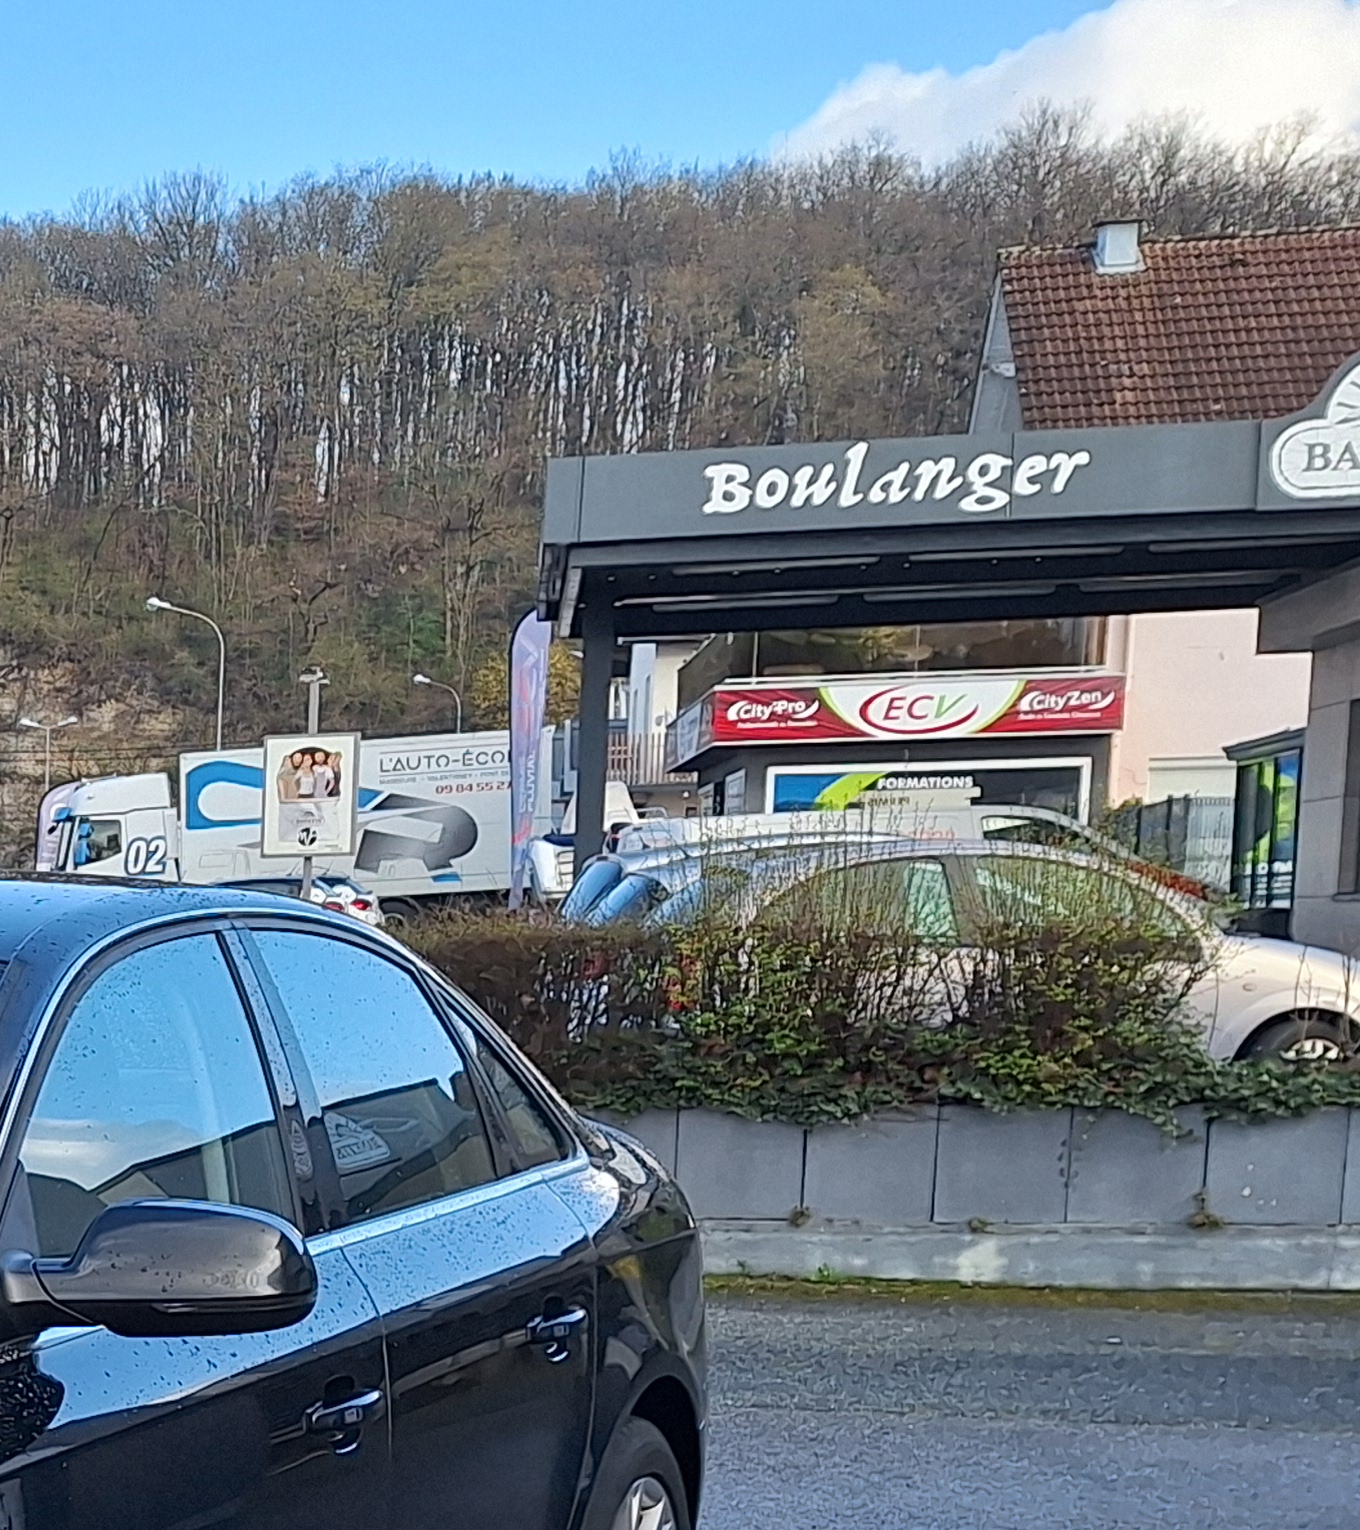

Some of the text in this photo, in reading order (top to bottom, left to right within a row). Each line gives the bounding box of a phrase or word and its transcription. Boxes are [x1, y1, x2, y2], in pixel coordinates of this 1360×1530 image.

[702, 441, 1091, 515] Boulanger
[883, 694, 967, 720] ECV
[877, 776, 974, 790] FORMATIONS
[124, 835, 168, 876] 02
